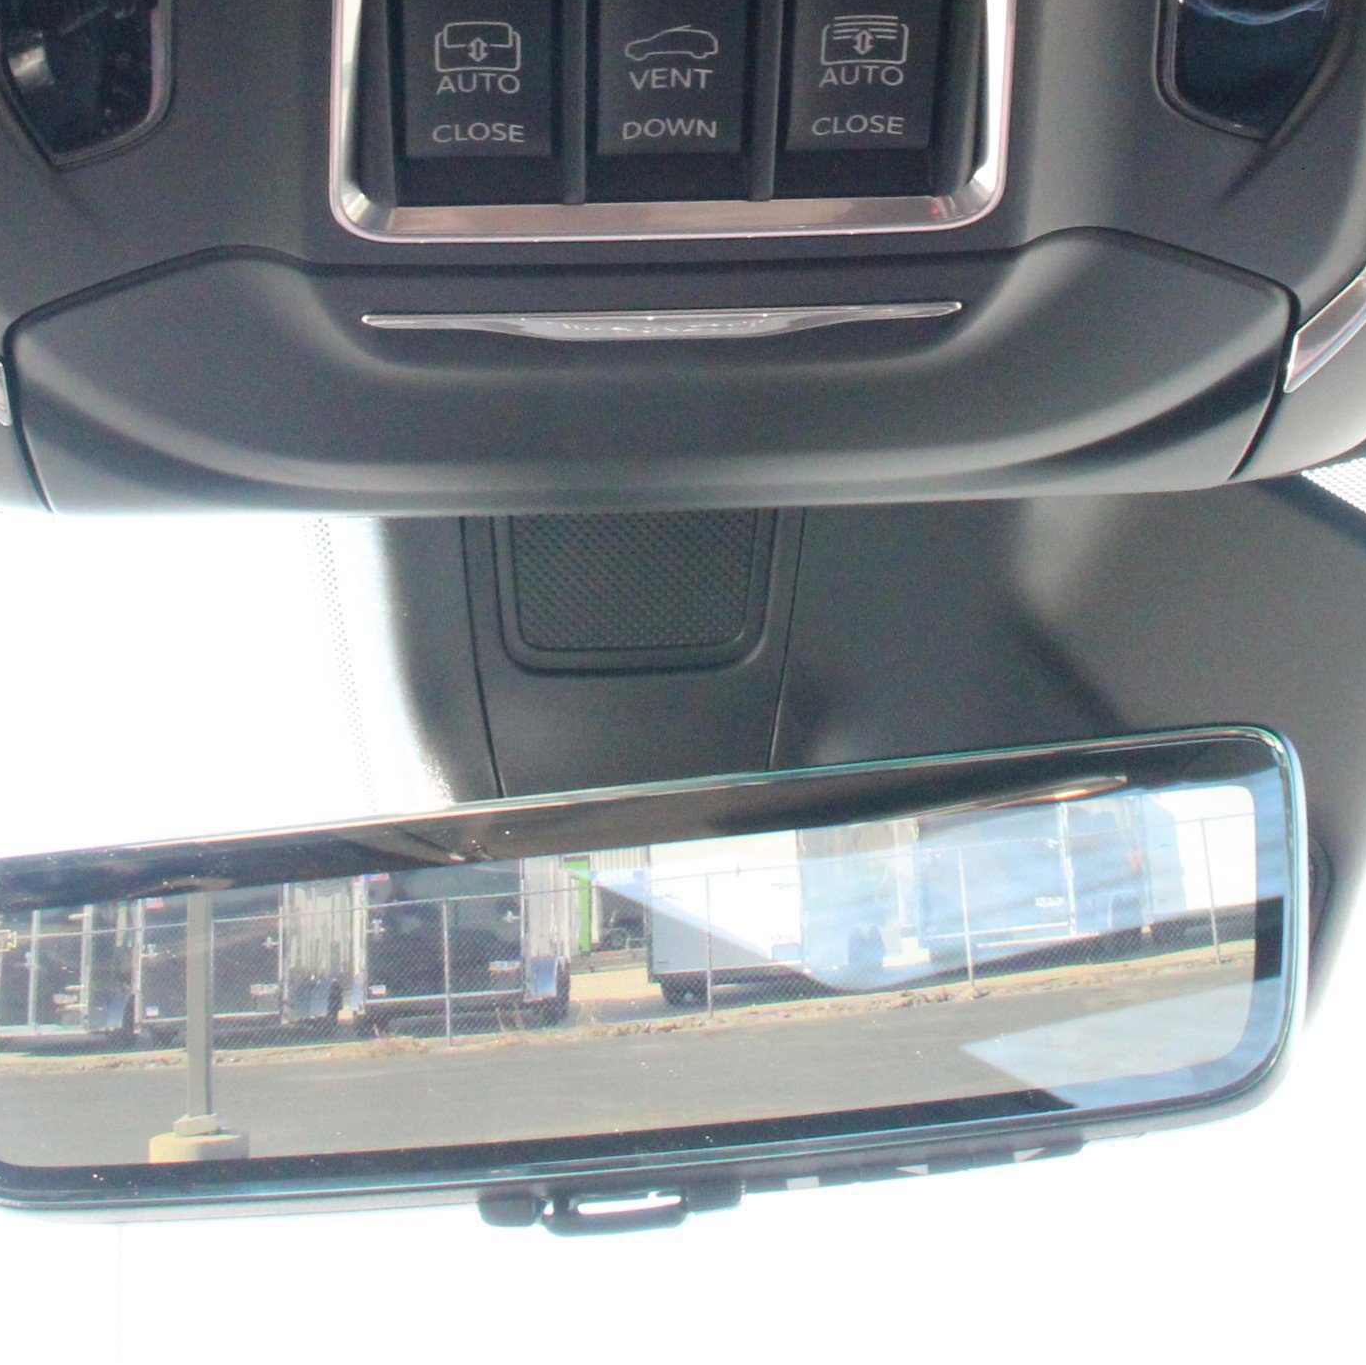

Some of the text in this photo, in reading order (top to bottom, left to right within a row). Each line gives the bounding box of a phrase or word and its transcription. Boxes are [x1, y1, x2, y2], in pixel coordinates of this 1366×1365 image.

[436, 72, 521, 96] AUTO
[628, 67, 713, 91] VENT
[818, 64, 905, 89] AUTO
[431, 121, 525, 144] CLOSE
[621, 118, 717, 141] DOWN
[810, 114, 904, 137] CLOSE
